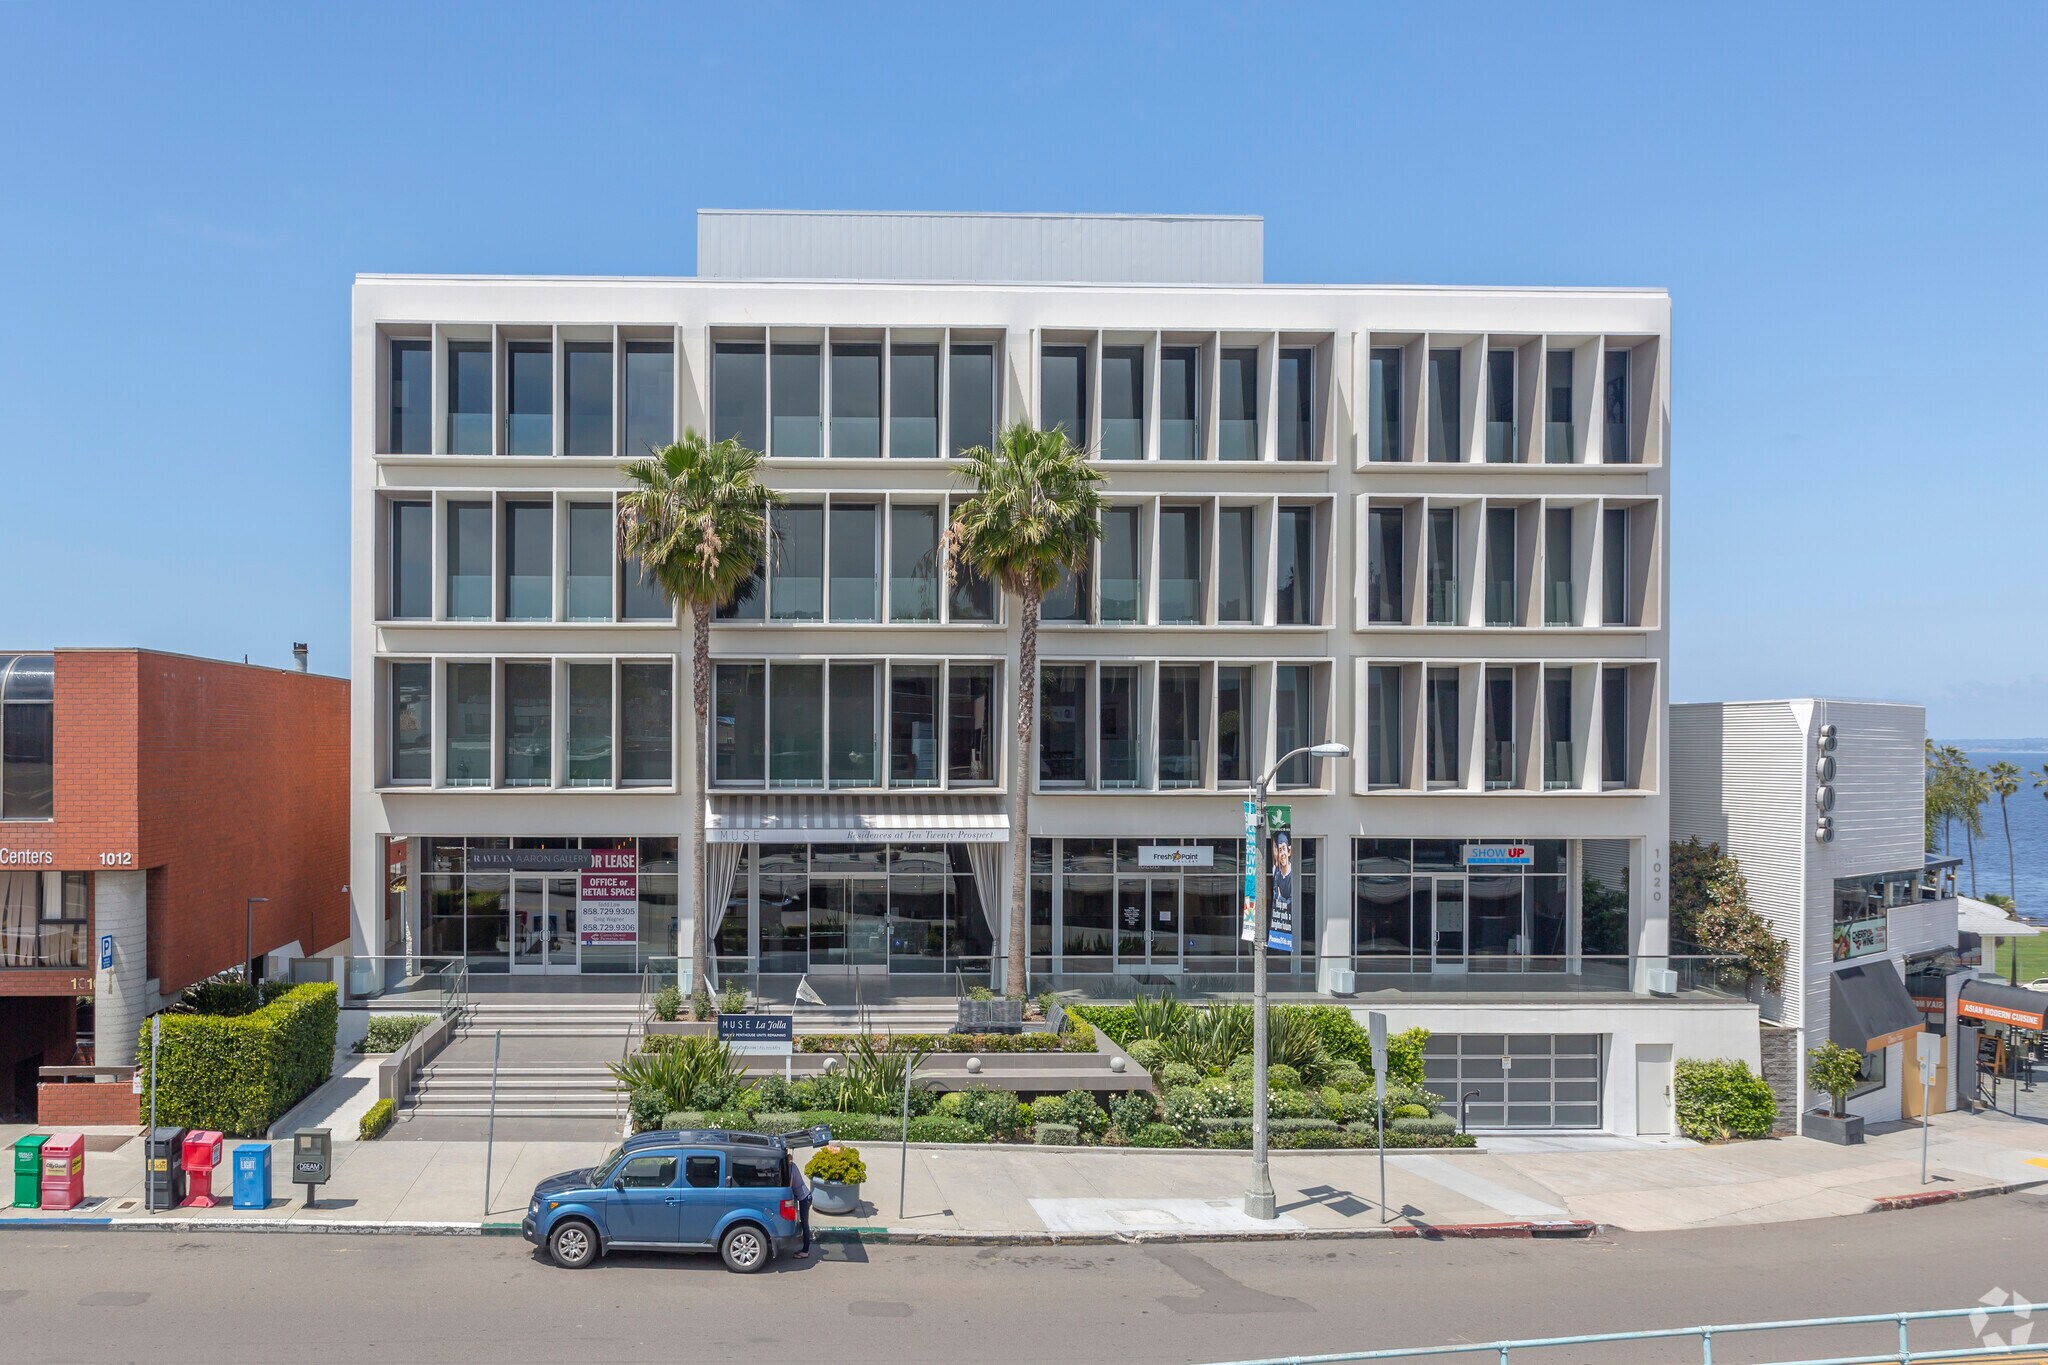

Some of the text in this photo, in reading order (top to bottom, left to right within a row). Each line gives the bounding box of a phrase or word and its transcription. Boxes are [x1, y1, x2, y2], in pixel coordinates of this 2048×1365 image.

[720, 830, 760, 841] MUSE
[847, 830, 994, 841] Residences at Ten Twenty Prospect
[0, 848, 53, 864] Centers
[1472, 848, 1525, 857] SHOW UP
[99, 852, 132, 865] 1012
[516, 854, 551, 863] AARON
[553, 854, 589, 863] GALLERY
[605, 855, 635, 868] LEASE
[1653, 848, 1662, 901] 1020
[590, 877, 618, 886] OFFICE
[582, 888, 636, 896] RETAIL SPACE
[1964, 1004, 2039, 1025] ASIAN MODERN CUISINE
[722, 1021, 787, 1030] MUSE La Jolla
[299, 1163, 320, 1171] DREAM
